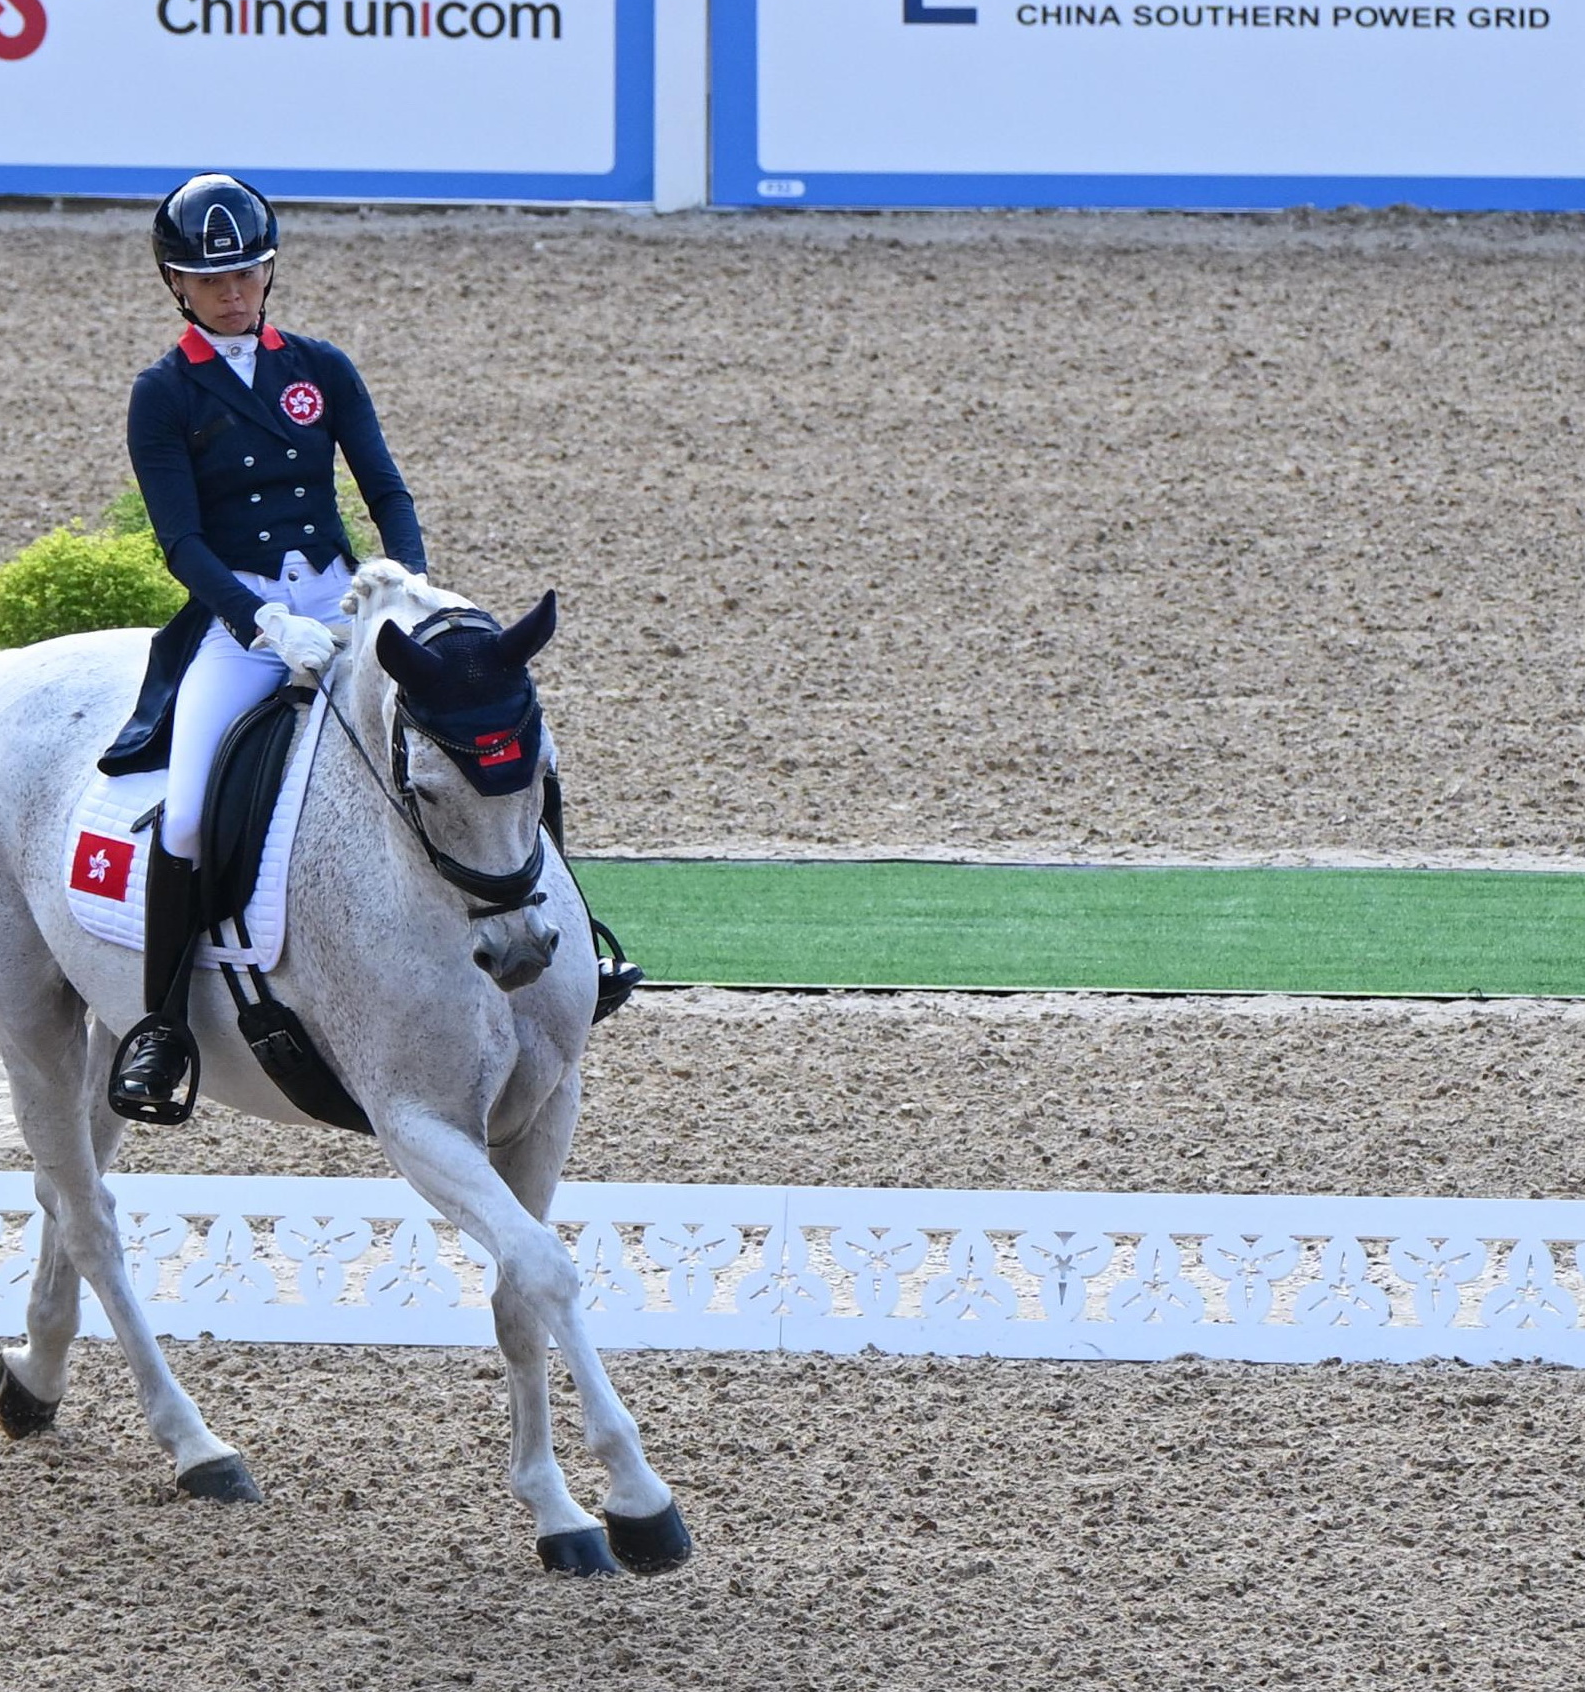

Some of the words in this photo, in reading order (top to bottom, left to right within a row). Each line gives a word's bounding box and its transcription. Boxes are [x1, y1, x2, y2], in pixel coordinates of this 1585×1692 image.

[1016, 4, 1122, 26] CHINA
[1133, 4, 1321, 28] SOUTHERN
[1332, 5, 1457, 29] POWER
[1467, 6, 1551, 29] GRID
